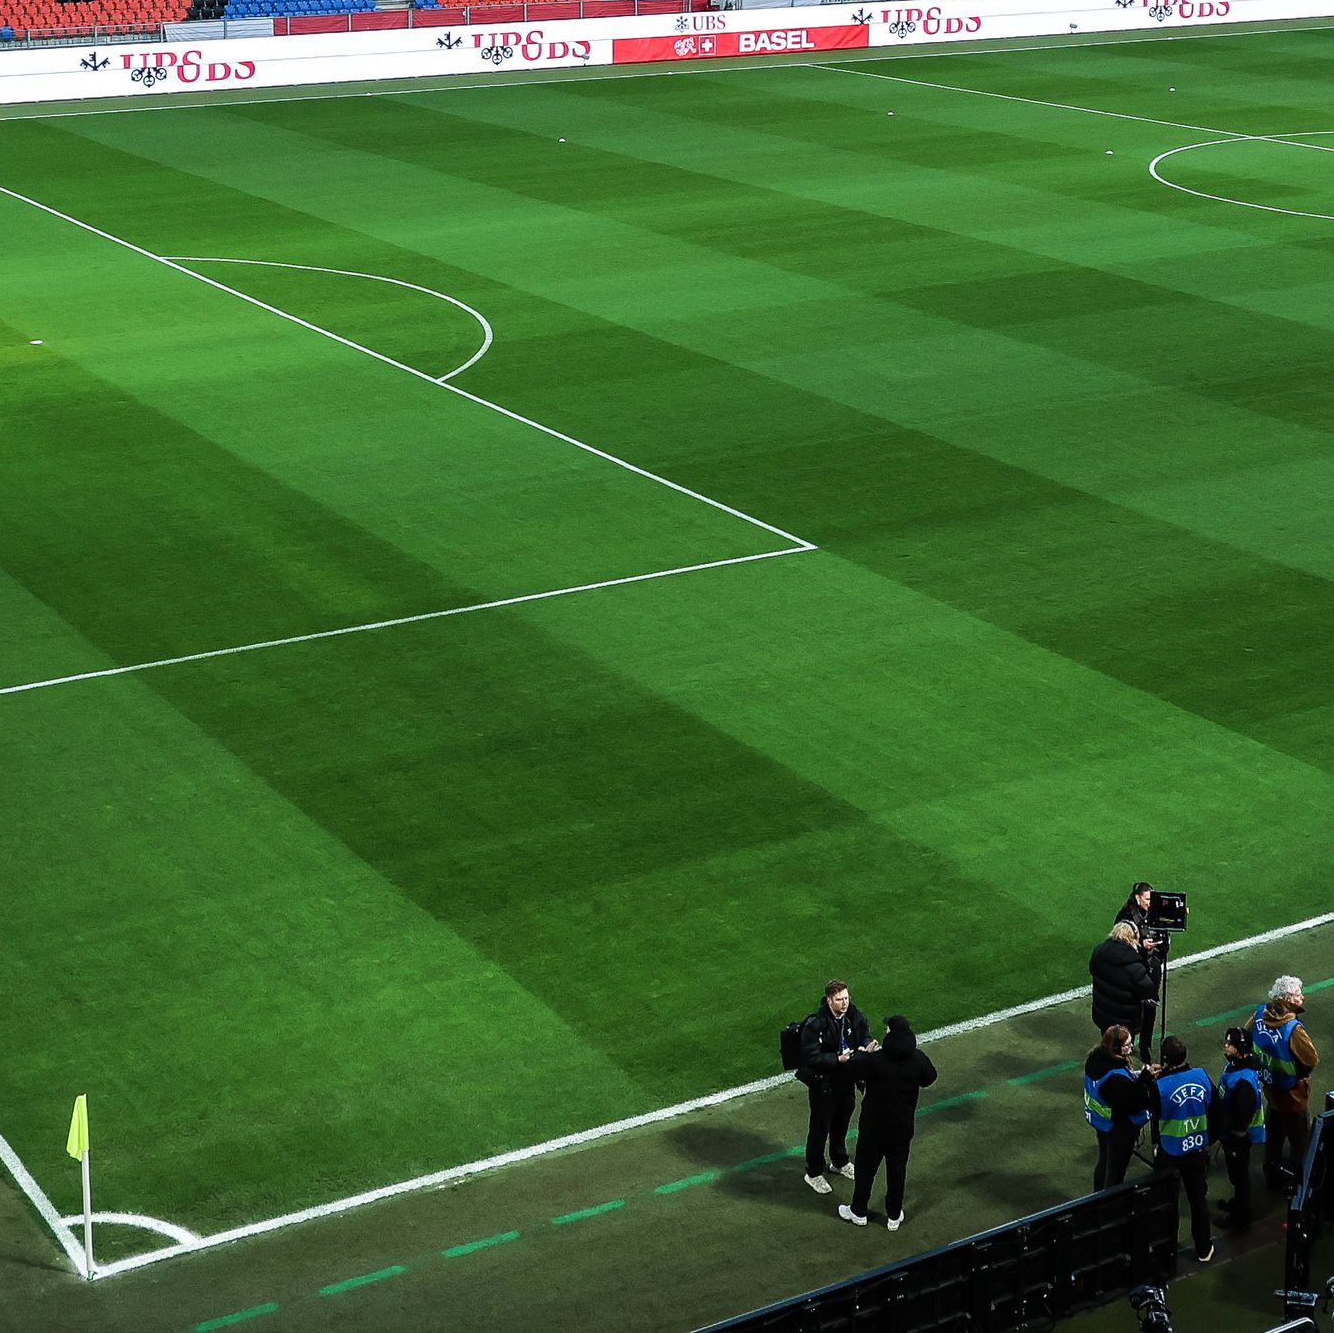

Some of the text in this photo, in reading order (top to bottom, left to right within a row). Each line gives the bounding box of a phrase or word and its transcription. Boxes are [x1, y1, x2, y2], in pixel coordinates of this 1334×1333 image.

[692, 15, 726, 31] UBS
[739, 30, 814, 53] BASEL
[1172, 1087, 1206, 1104] UEFA
[1184, 1119, 1199, 1133] TV
[1182, 1134, 1203, 1152] 830
